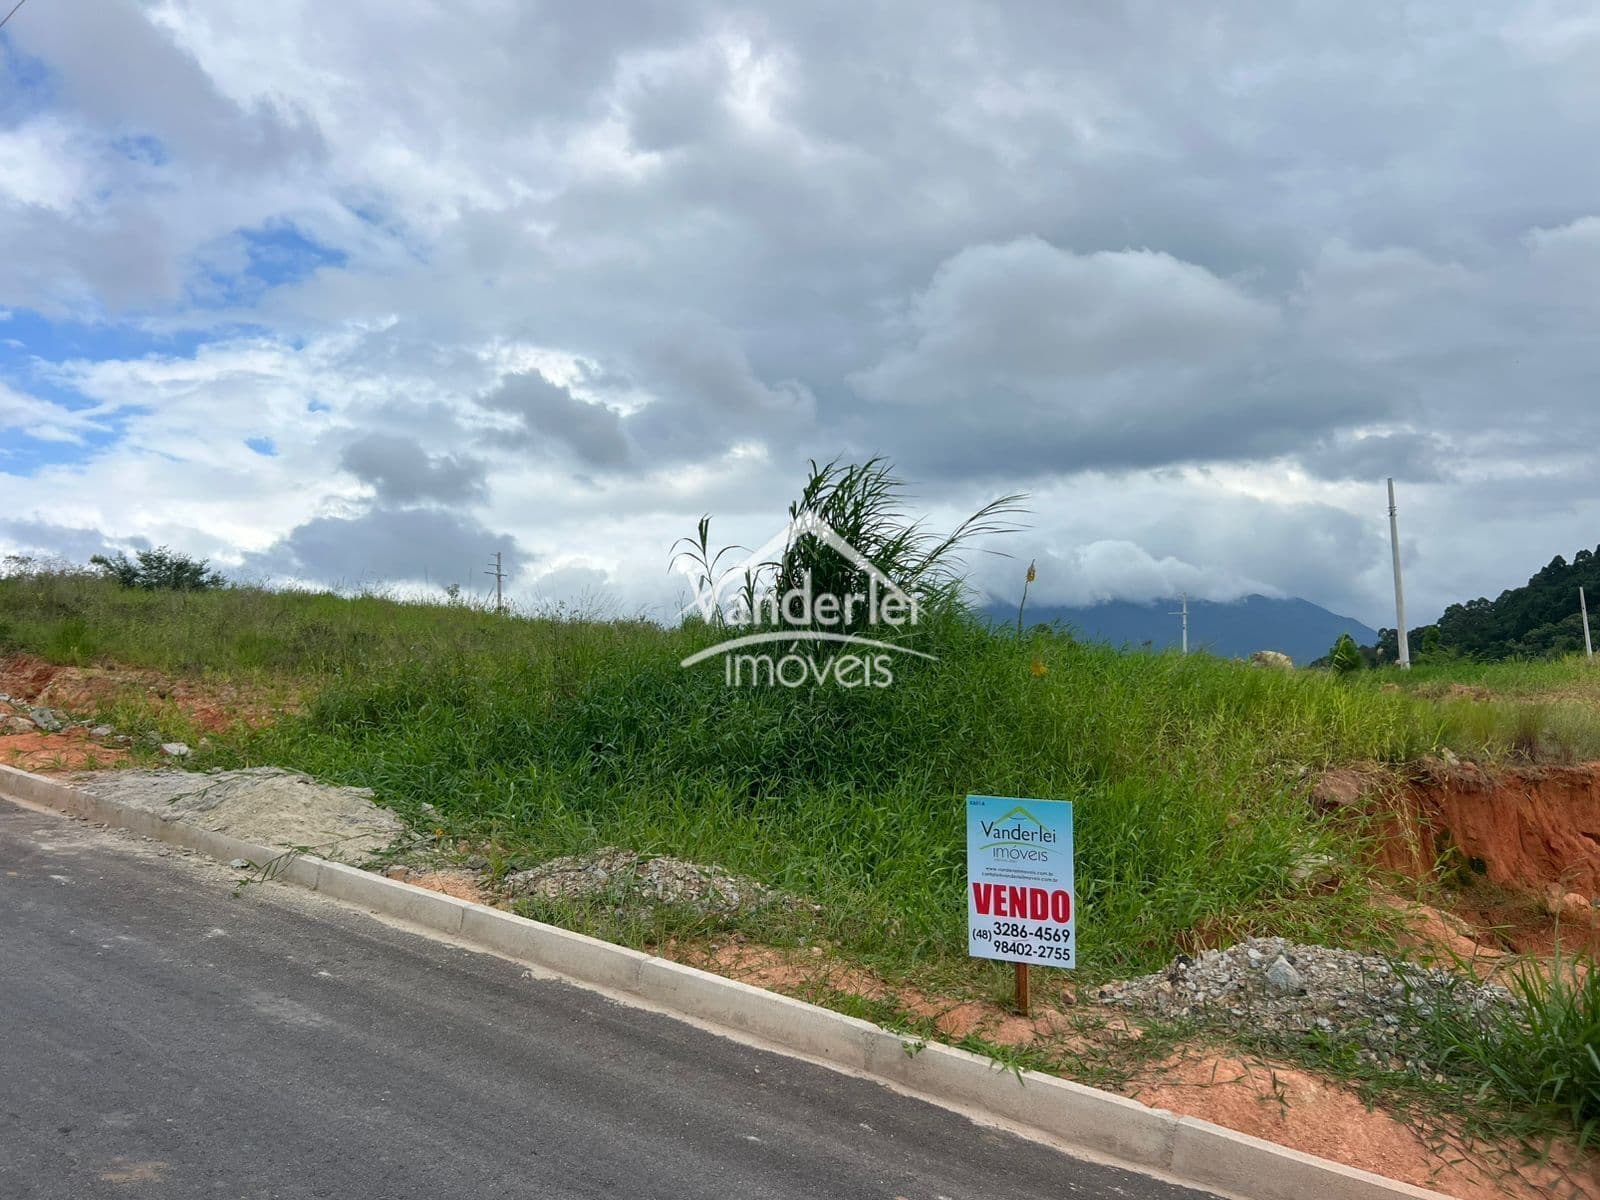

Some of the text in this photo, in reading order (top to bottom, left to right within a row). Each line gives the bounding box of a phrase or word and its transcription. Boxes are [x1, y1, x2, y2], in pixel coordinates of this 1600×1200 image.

[980, 820, 1056, 843] Vanderlei
[992, 845, 1048, 862] imóveis
[972, 882, 1070, 924] VENDO
[972, 921, 1070, 943] (48) 3286-4569
[993, 940, 1070, 961] 98402-2755
